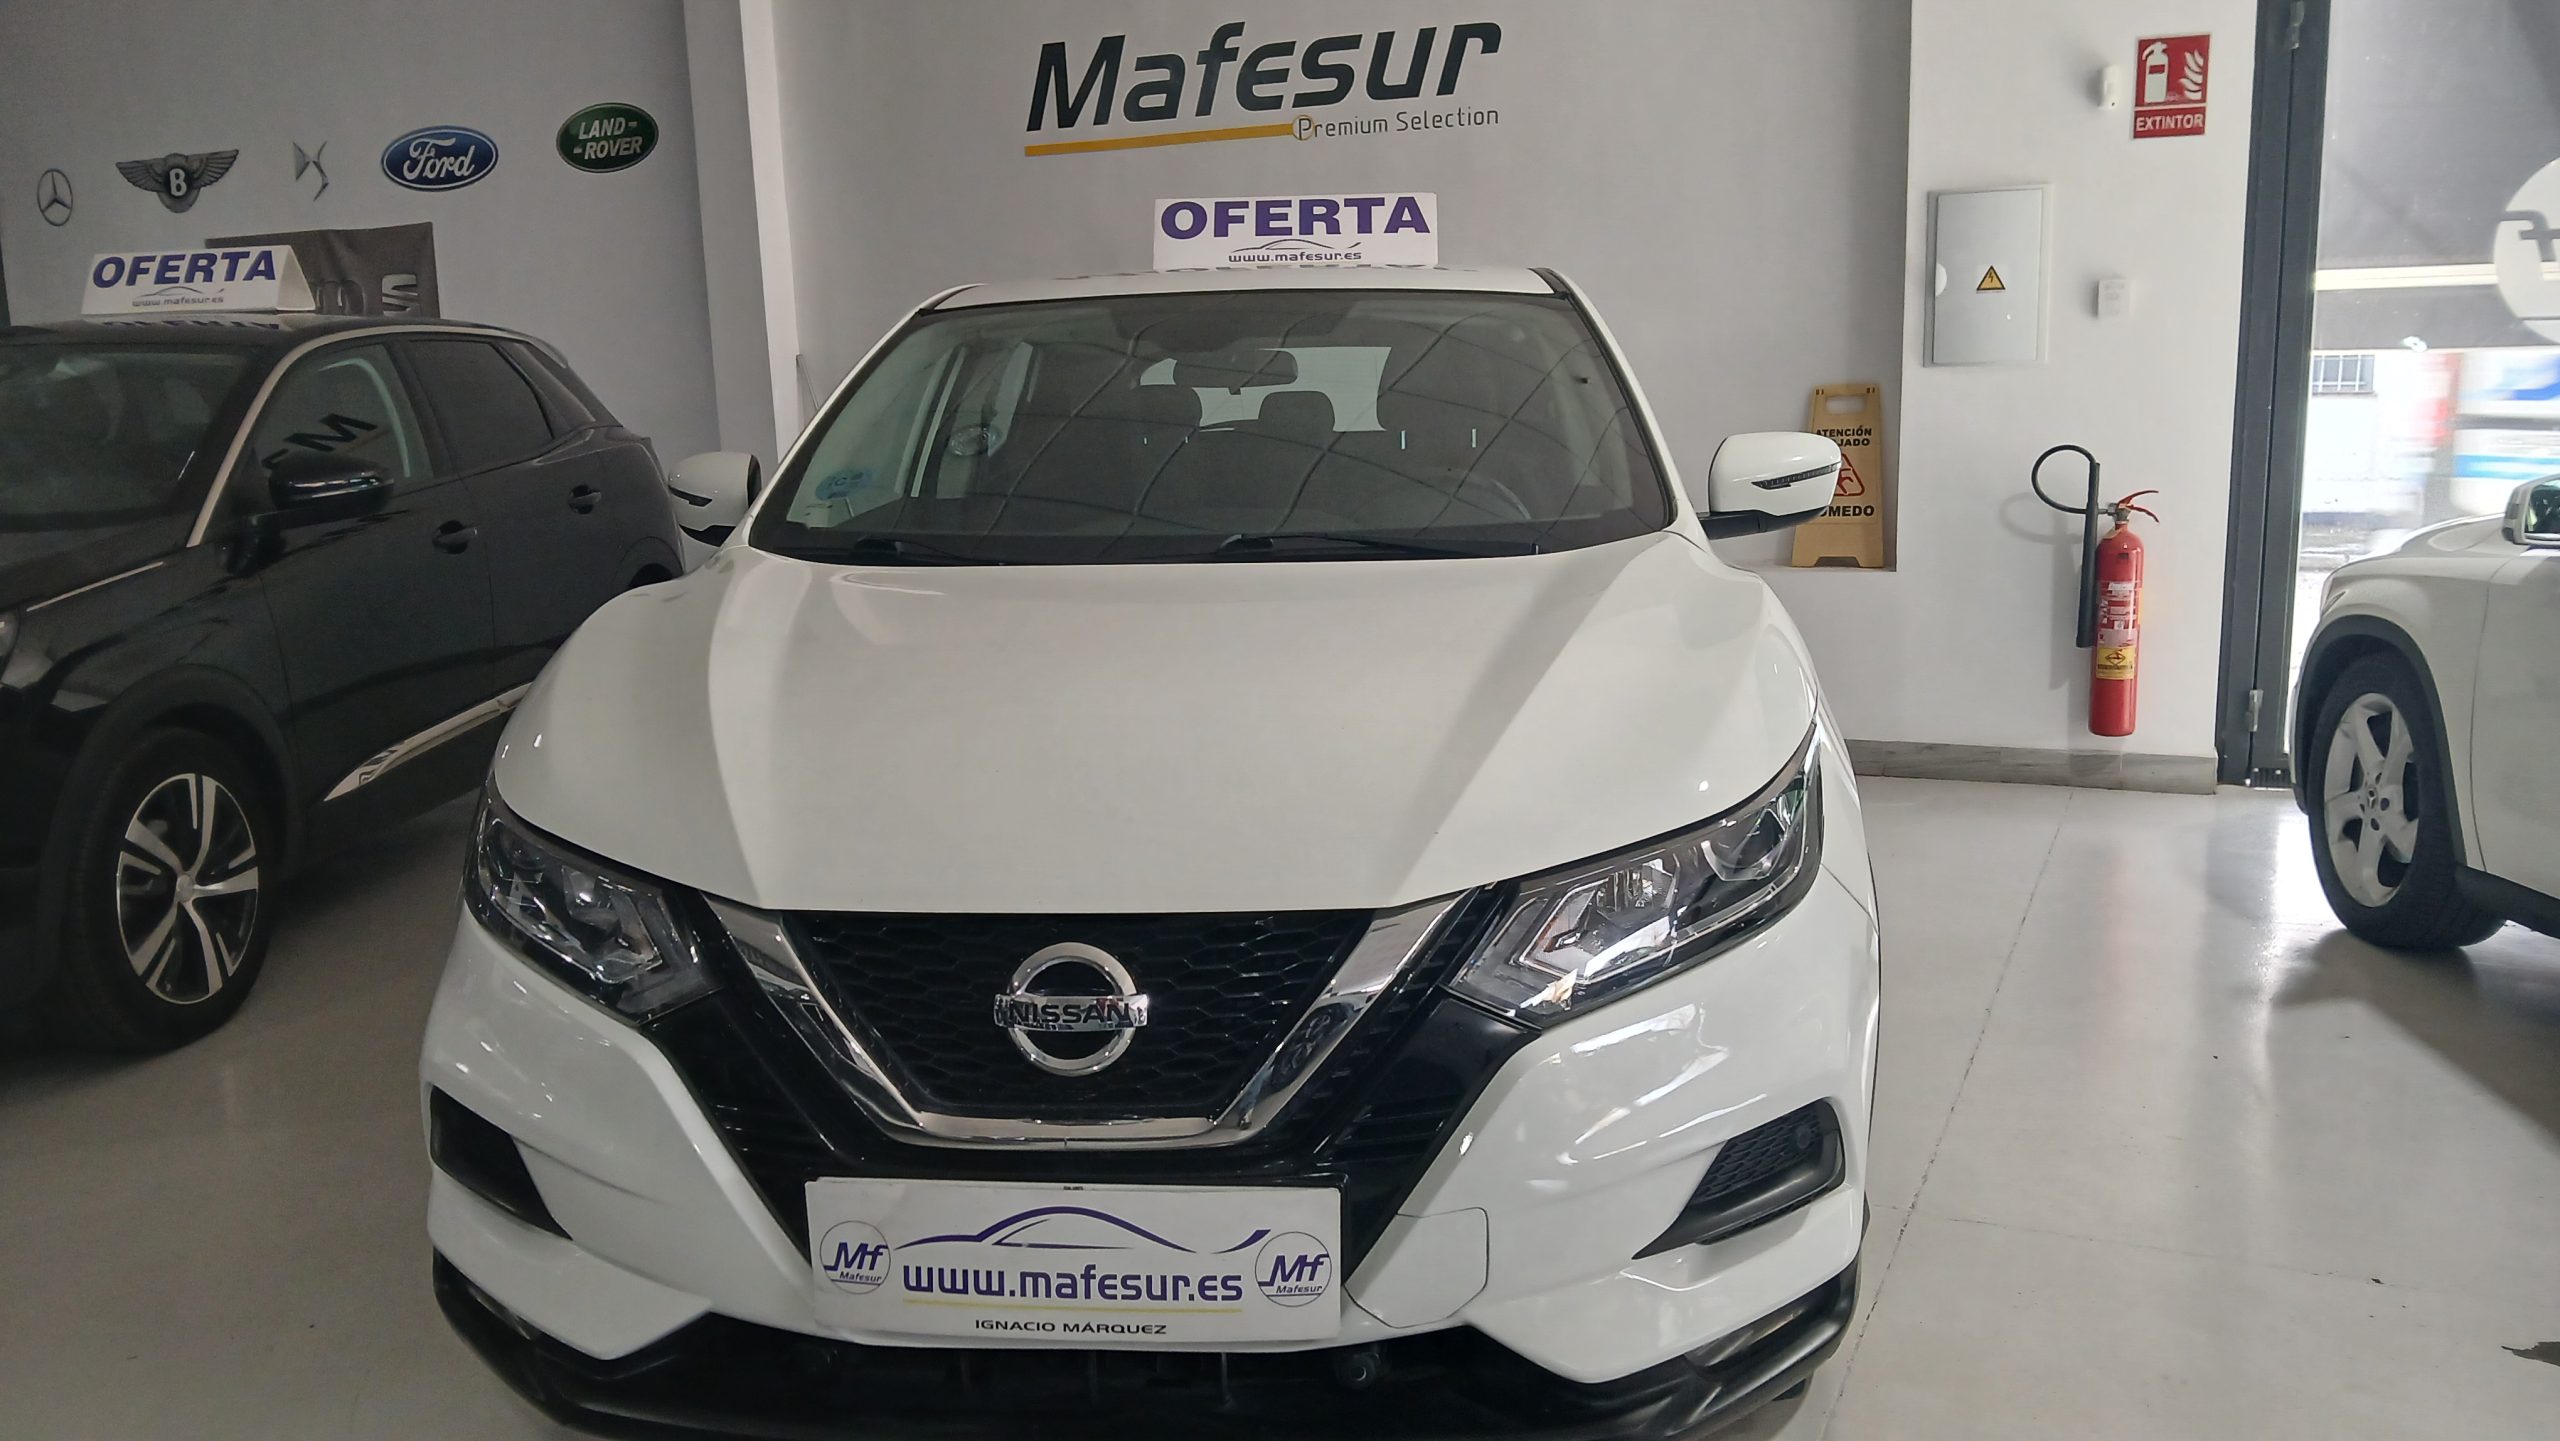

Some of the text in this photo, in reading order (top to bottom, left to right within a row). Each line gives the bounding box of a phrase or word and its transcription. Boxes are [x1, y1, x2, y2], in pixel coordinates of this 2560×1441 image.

[1026, 21, 1502, 132] Mafesur
[1298, 106, 1500, 141] Premium Selection
[2136, 113, 2204, 132] EXTINTOR
[403, 137, 475, 180] Ford
[1160, 196, 1431, 240] OFERTA
[1228, 250, 1362, 263] www.mafesur.es
[92, 250, 276, 288] OFERTA
[1816, 425, 1872, 437] ATENCIÓN
[1838, 438, 1870, 446] JADO
[1820, 505, 1875, 517] MEDO
[1009, 1002, 1130, 1026] NISSAN
[839, 1271, 882, 1283] Mafesur
[903, 1264, 1243, 1302] www.mafesur.es
[1276, 1285, 1323, 1294] Mafesur
[975, 1319, 1167, 1334] IGNACIO MÁRQUEZ
